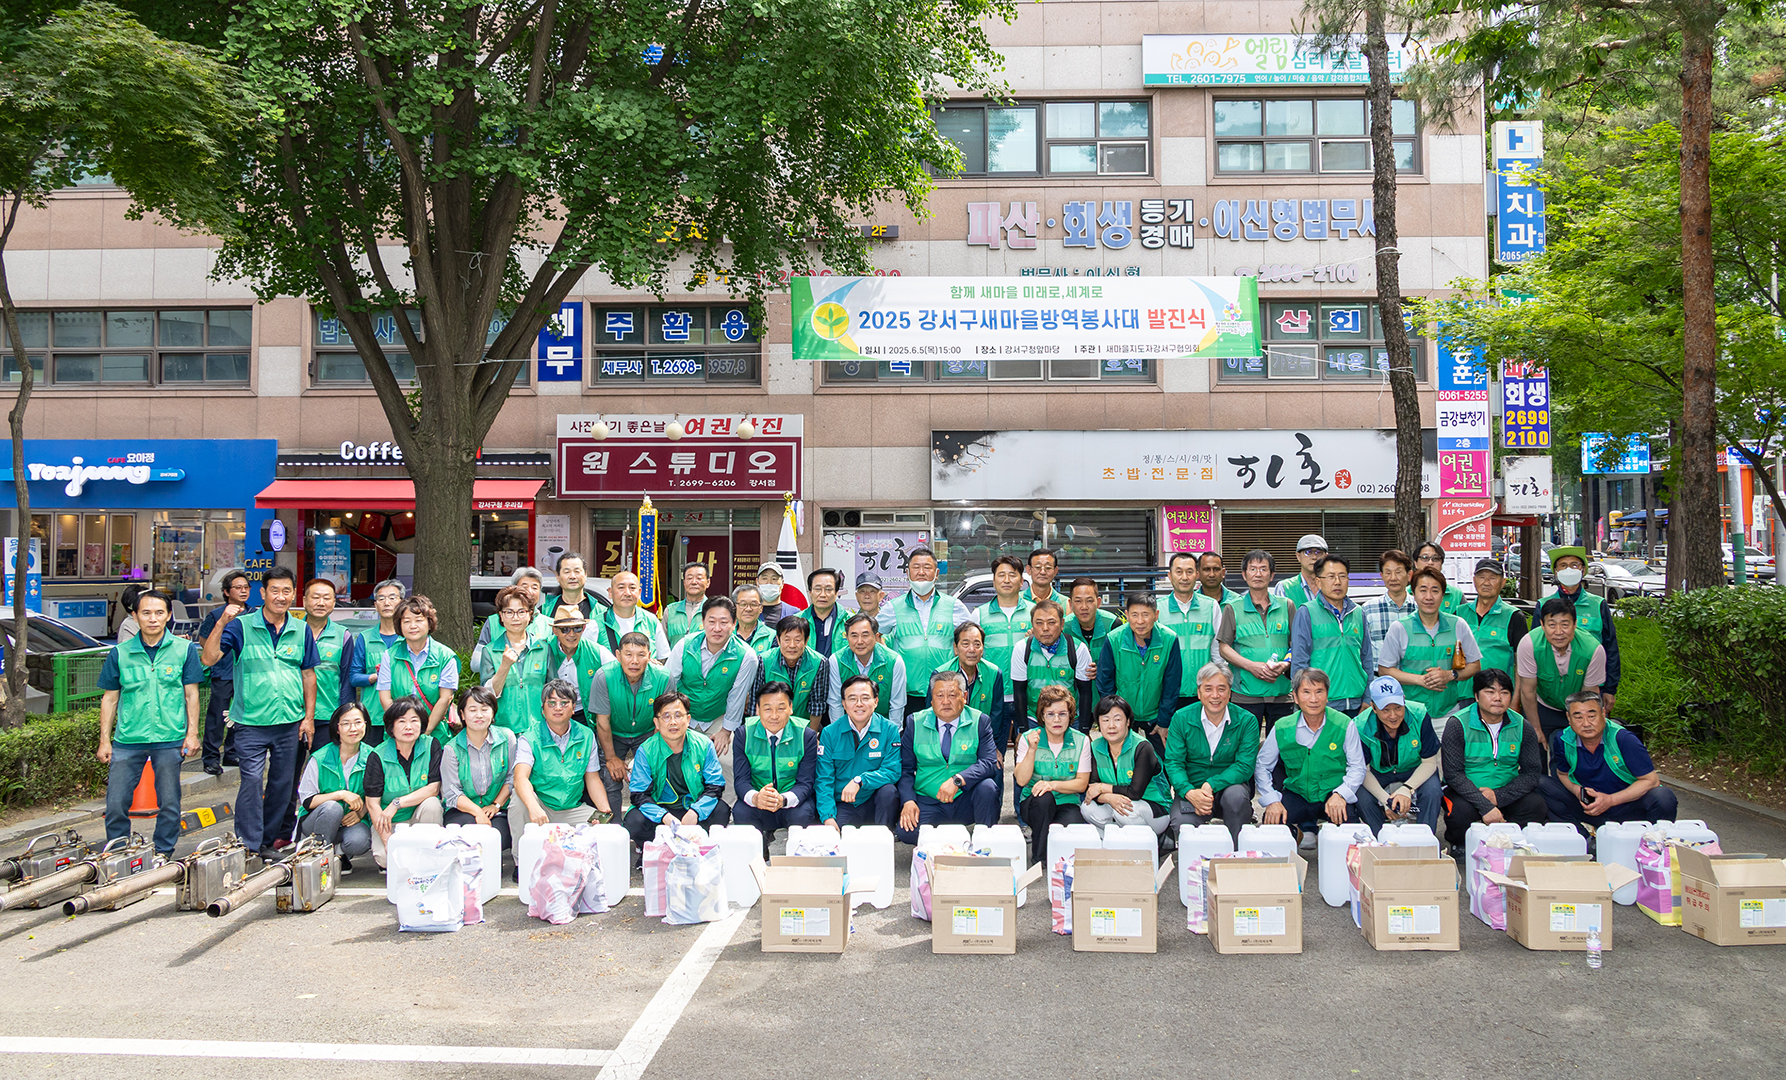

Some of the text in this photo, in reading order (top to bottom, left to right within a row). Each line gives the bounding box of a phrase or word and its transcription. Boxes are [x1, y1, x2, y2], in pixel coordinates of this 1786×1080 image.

[1245, 37, 1288, 71] 엘림
[1191, 74, 1246, 83] 2601-7975
[1273, 74, 1287, 82] 놀이
[1292, 74, 1306, 82] 미술
[1140, 199, 1195, 224] 등기
[871, 225, 887, 237] 2F
[1140, 224, 1195, 249] 경매
[1258, 265, 1360, 283] 2699-2100
[950, 285, 1104, 299] 함께 새마을 미래로,세계로
[858, 311, 911, 329] 2025
[918, 309, 1140, 331] 강서구새마을방역봉사대
[1147, 308, 1206, 330] 발진식
[318, 316, 396, 344] 법사
[546, 308, 575, 375] 세무
[864, 346, 881, 355] 일시
[980, 345, 1060, 355] 장소 강서구청앞마당
[1080, 345, 1096, 354] 주관
[602, 360, 643, 375] 세무사
[1329, 352, 1366, 372] 내용
[1439, 390, 1487, 401] 6061-5255
[1505, 382, 1547, 407] 회생
[1440, 411, 1486, 427] 금강보청기
[1506, 410, 1548, 425] 2699
[570, 420, 622, 434] 사진기
[626, 420, 667, 434] 좋은날
[1455, 439, 1472, 448] 2층
[1506, 431, 1549, 446] 2100
[340, 440, 403, 460] Coffe
[126, 452, 155, 463] 요아정
[582, 451, 611, 475] 원
[1442, 453, 1474, 472] 여권
[668, 479, 776, 487] T. 2699-6206 강서점
[1453, 472, 1482, 489] 사진
[1357, 484, 1376, 494] (02)
[1166, 510, 1210, 524] 여권사진
[1173, 538, 1206, 550] 5분완성
[244, 558, 273, 569] CAFE
[1380, 683, 1394, 694] NY
